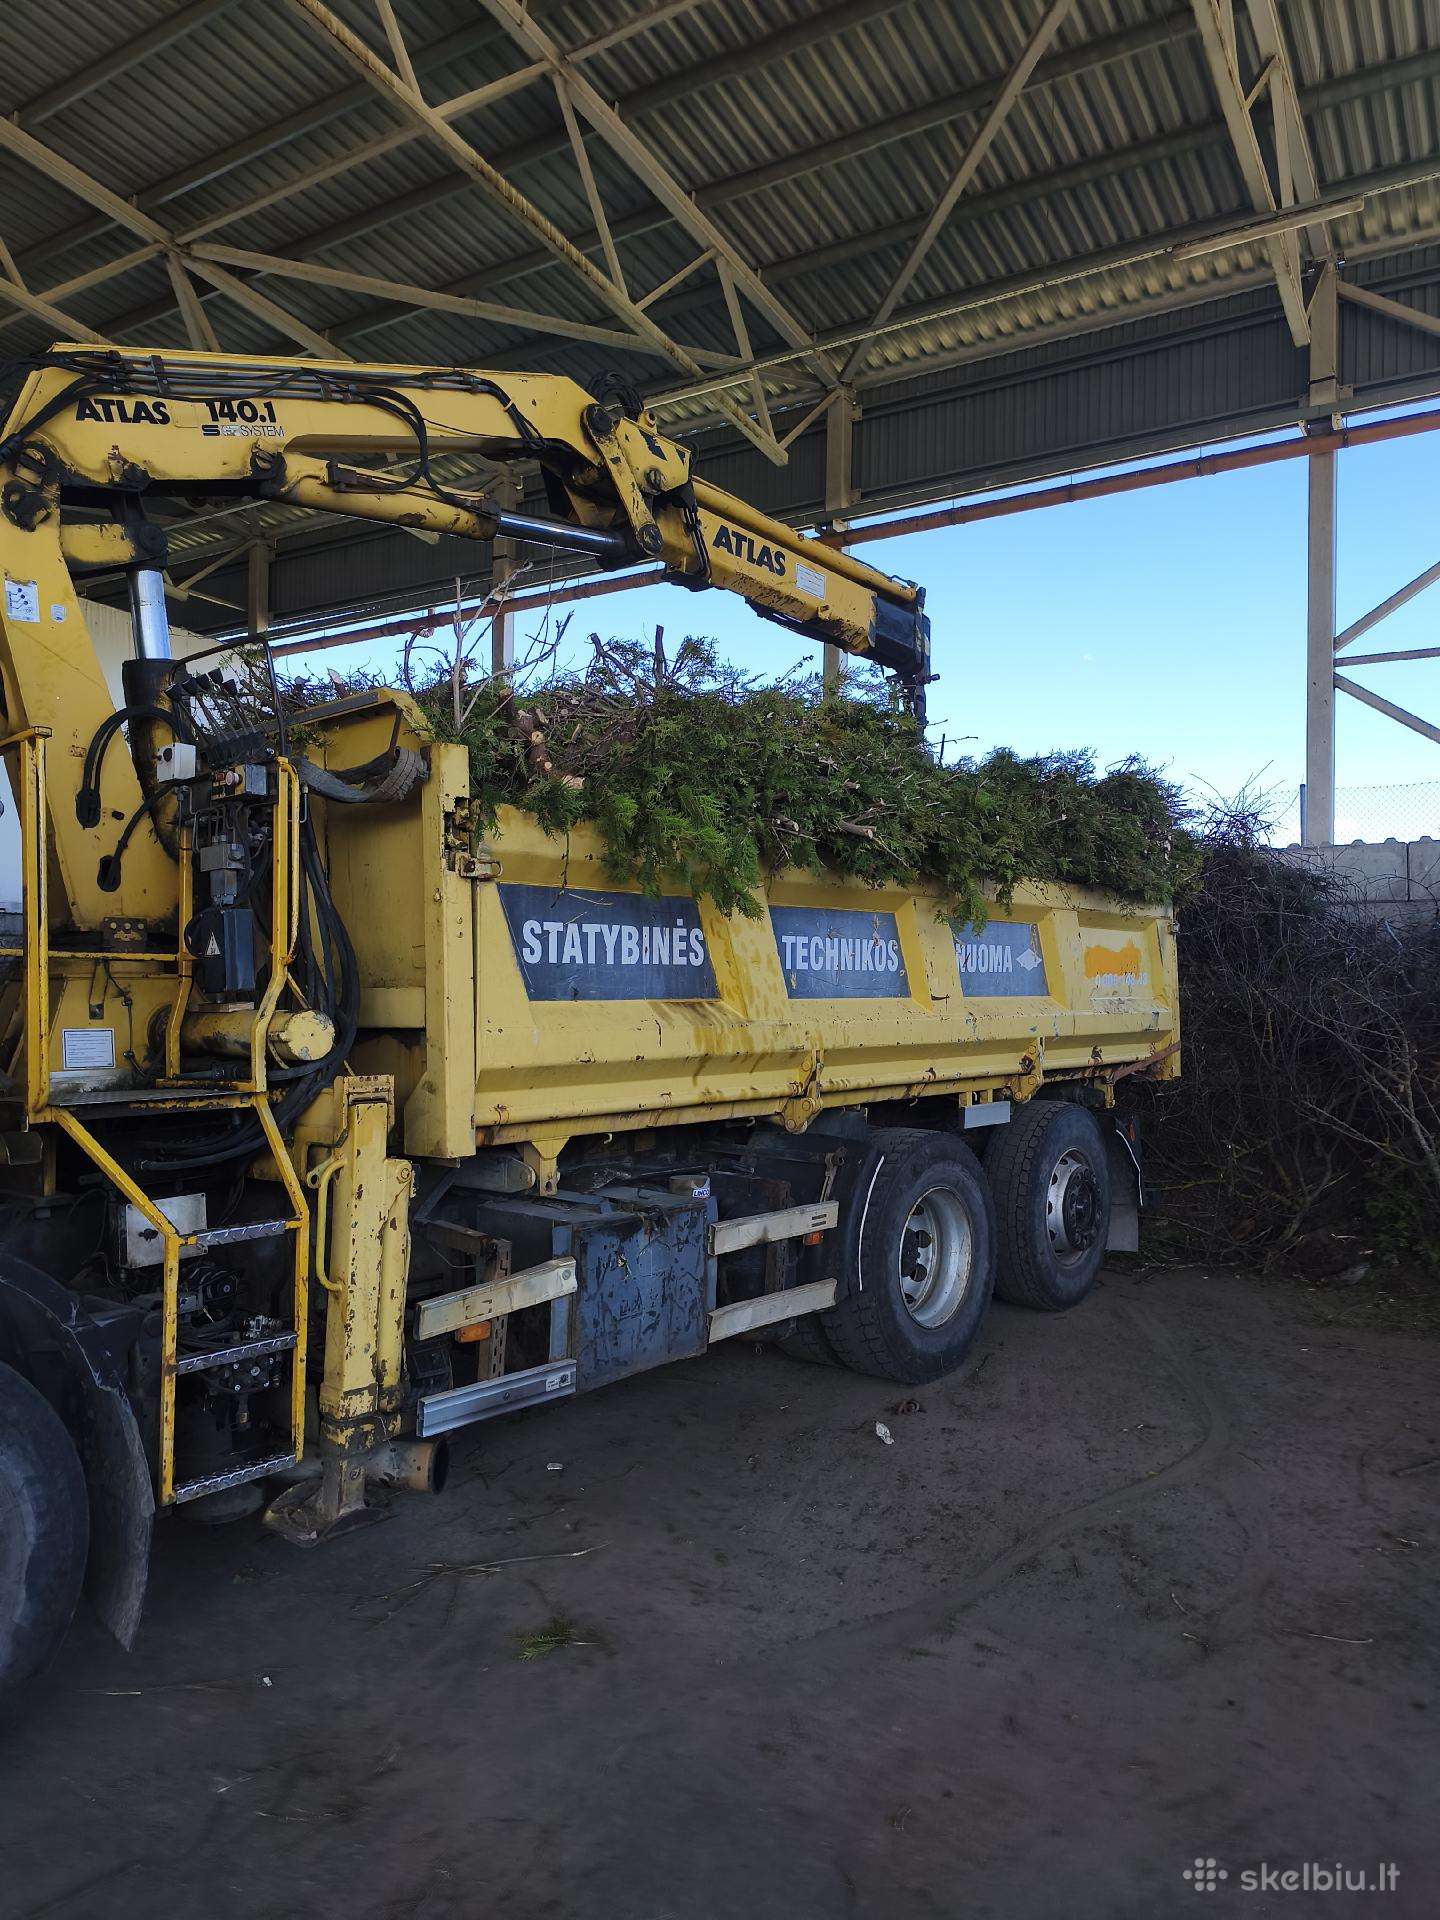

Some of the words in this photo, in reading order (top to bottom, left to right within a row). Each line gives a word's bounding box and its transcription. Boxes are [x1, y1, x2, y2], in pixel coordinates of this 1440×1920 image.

[75, 398, 171, 425] ATLAS
[203, 399, 277, 423] 140.1
[240, 425, 285, 437] SYSTEM
[712, 524, 786, 577] ATLAS
[522, 918, 705, 967] STATYBINĖS
[781, 935, 899, 972] TECHNIKOS
